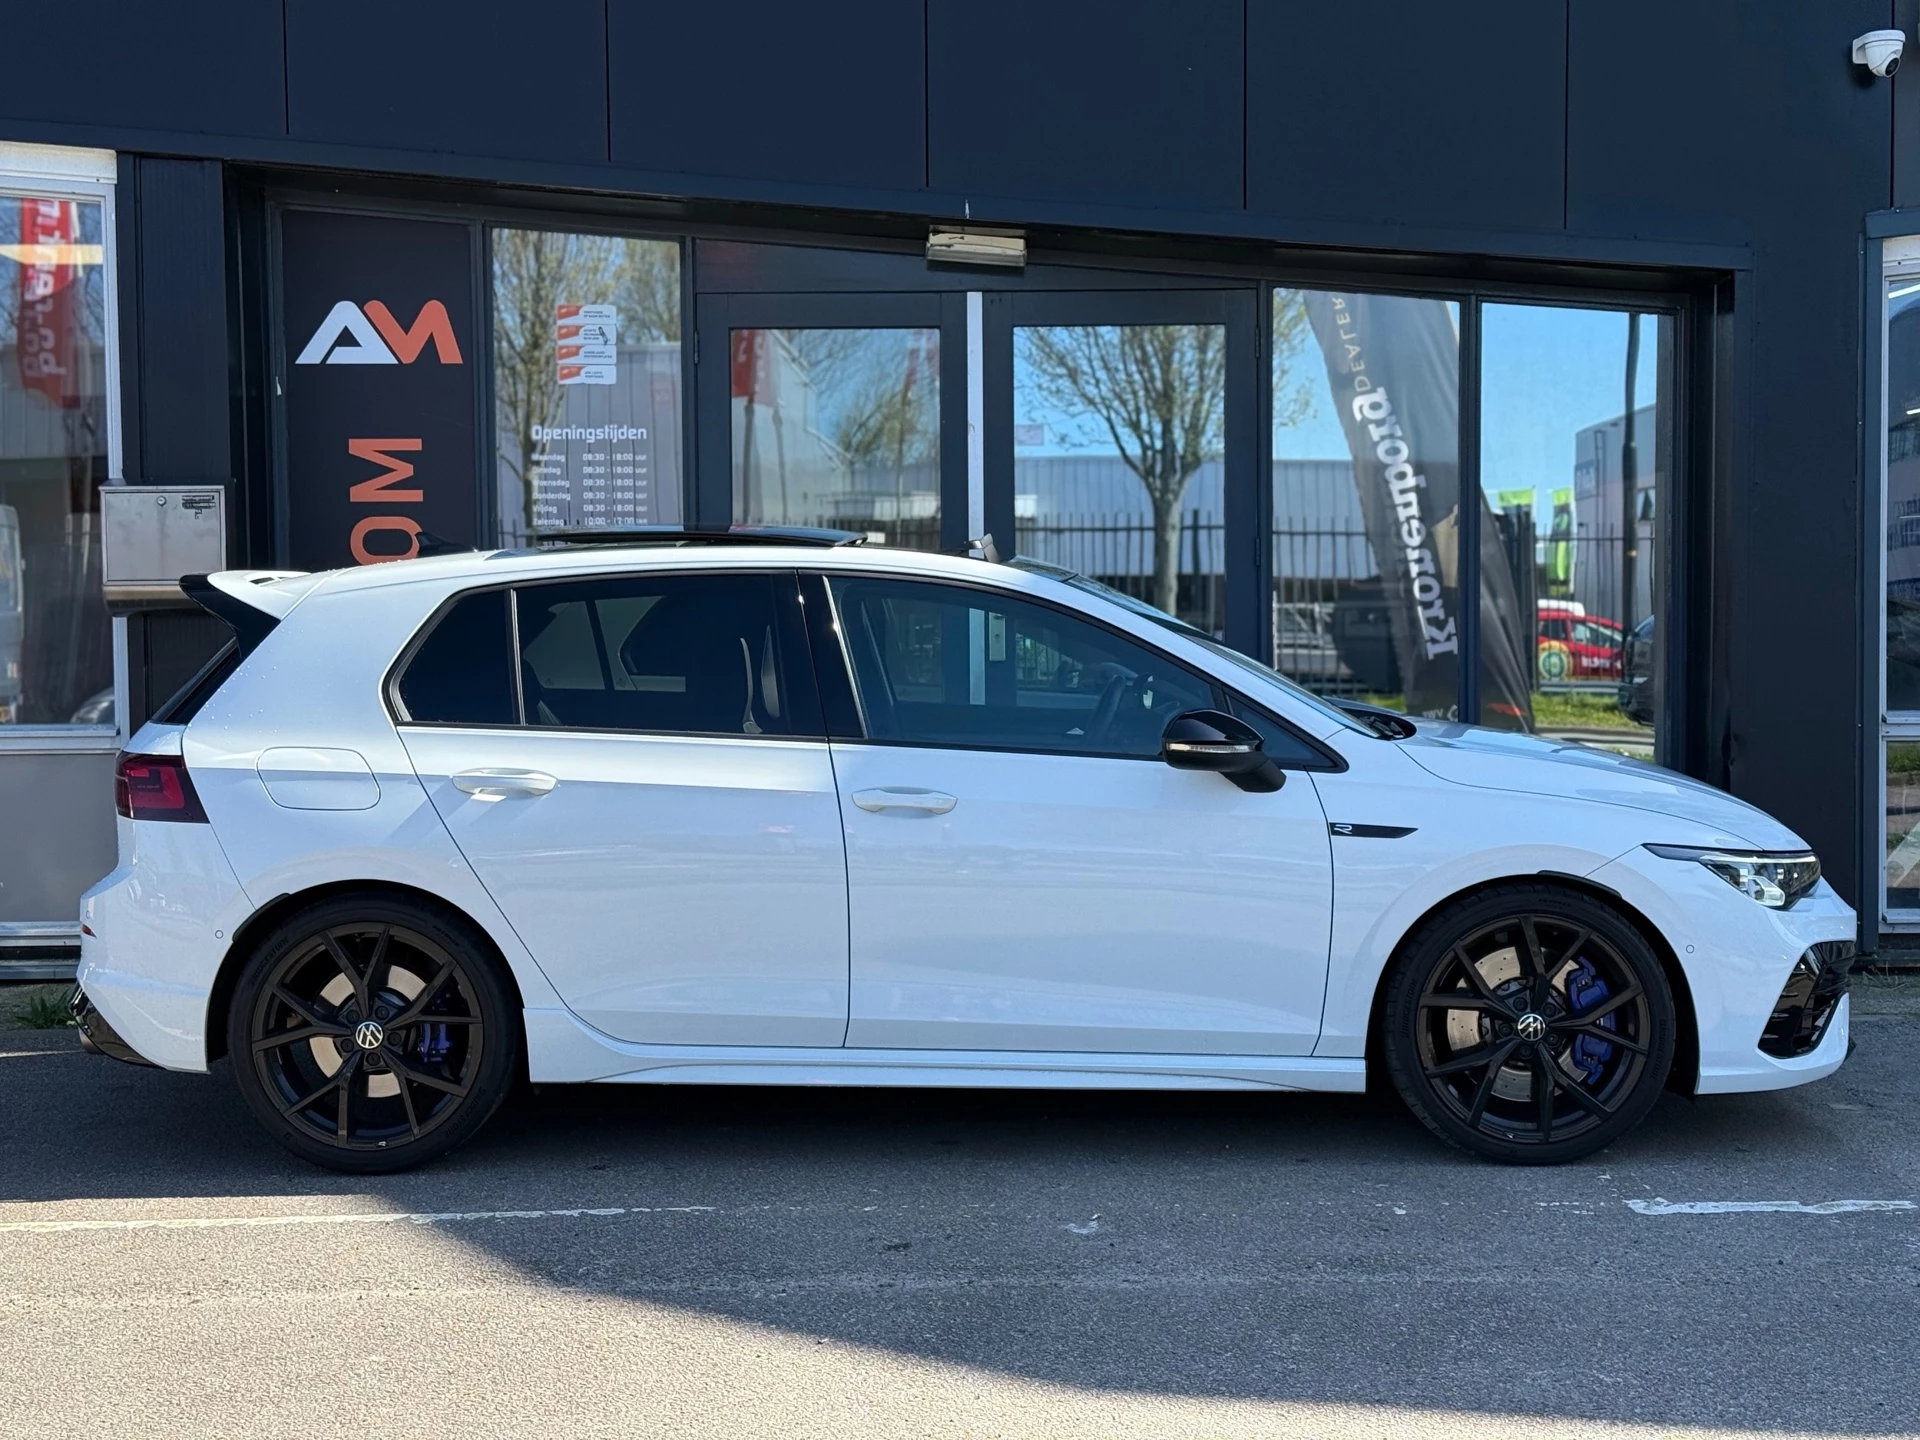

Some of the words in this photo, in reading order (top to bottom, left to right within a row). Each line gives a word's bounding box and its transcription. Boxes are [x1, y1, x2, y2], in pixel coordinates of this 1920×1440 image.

[294, 299, 464, 365] AM
[531, 423, 648, 444] Openingstijden
[1333, 824, 1353, 835] R
